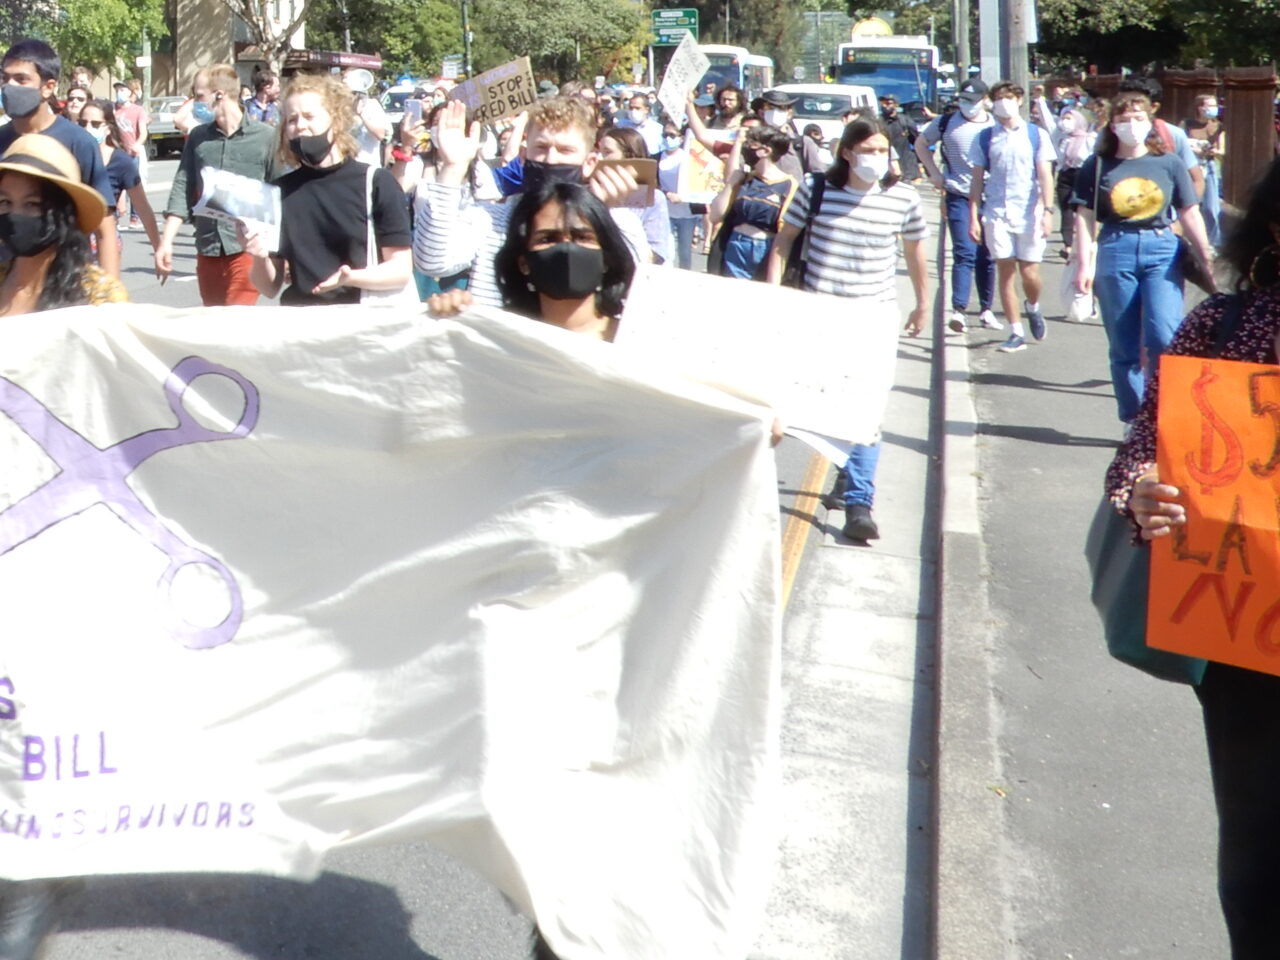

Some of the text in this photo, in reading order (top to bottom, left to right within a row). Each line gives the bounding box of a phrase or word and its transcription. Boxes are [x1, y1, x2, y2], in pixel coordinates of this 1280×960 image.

[487, 75, 523, 100] STOP
[1172, 486, 1280, 576] LA
[22, 731, 118, 781] BILL
